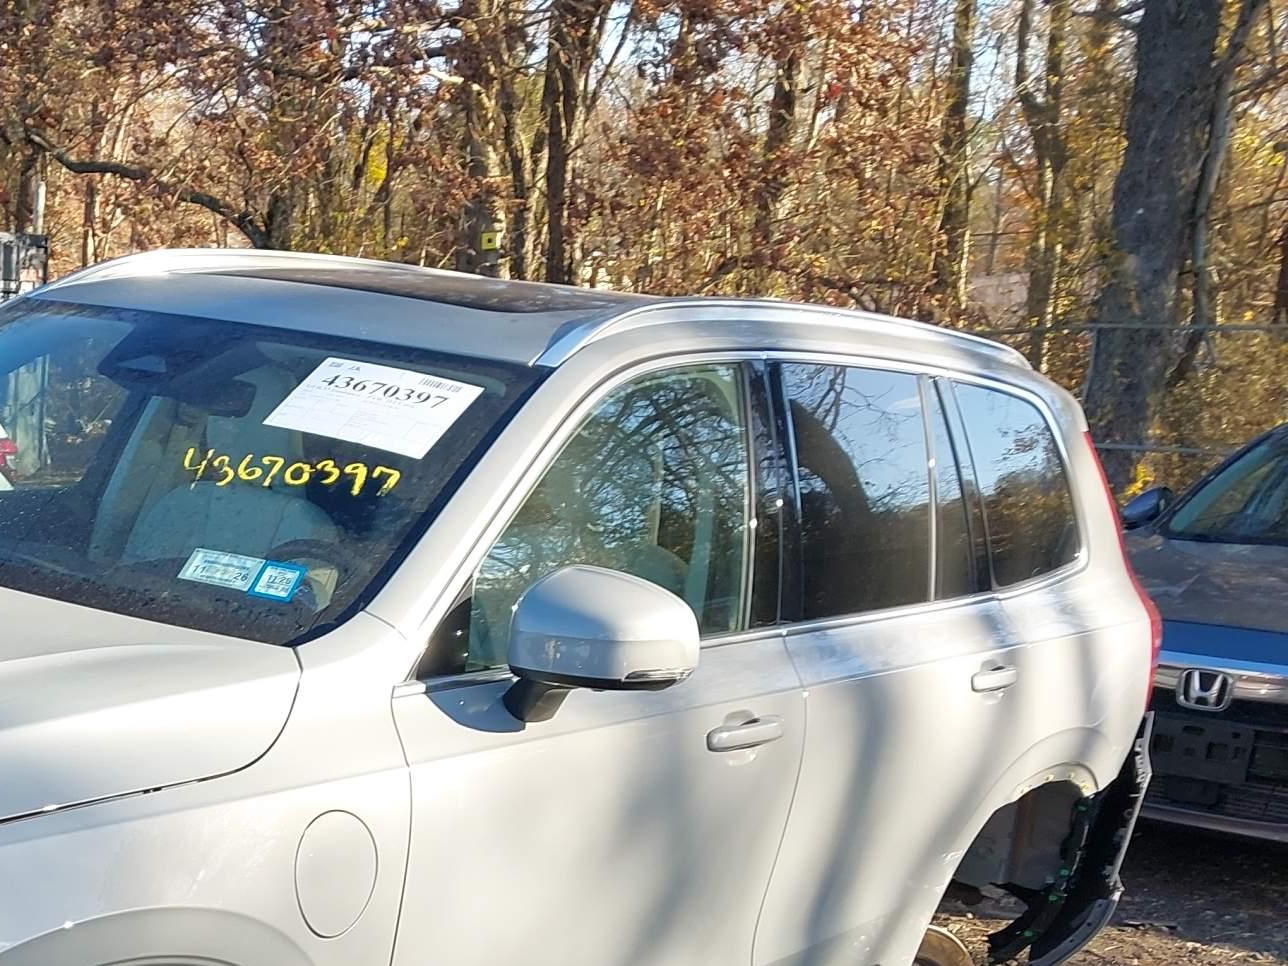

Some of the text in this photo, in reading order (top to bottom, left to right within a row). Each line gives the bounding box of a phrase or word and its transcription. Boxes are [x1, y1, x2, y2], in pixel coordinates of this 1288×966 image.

[322, 374, 449, 408] 43670397
[183, 447, 401, 496] 43670397
[233, 572, 248, 582] 26
